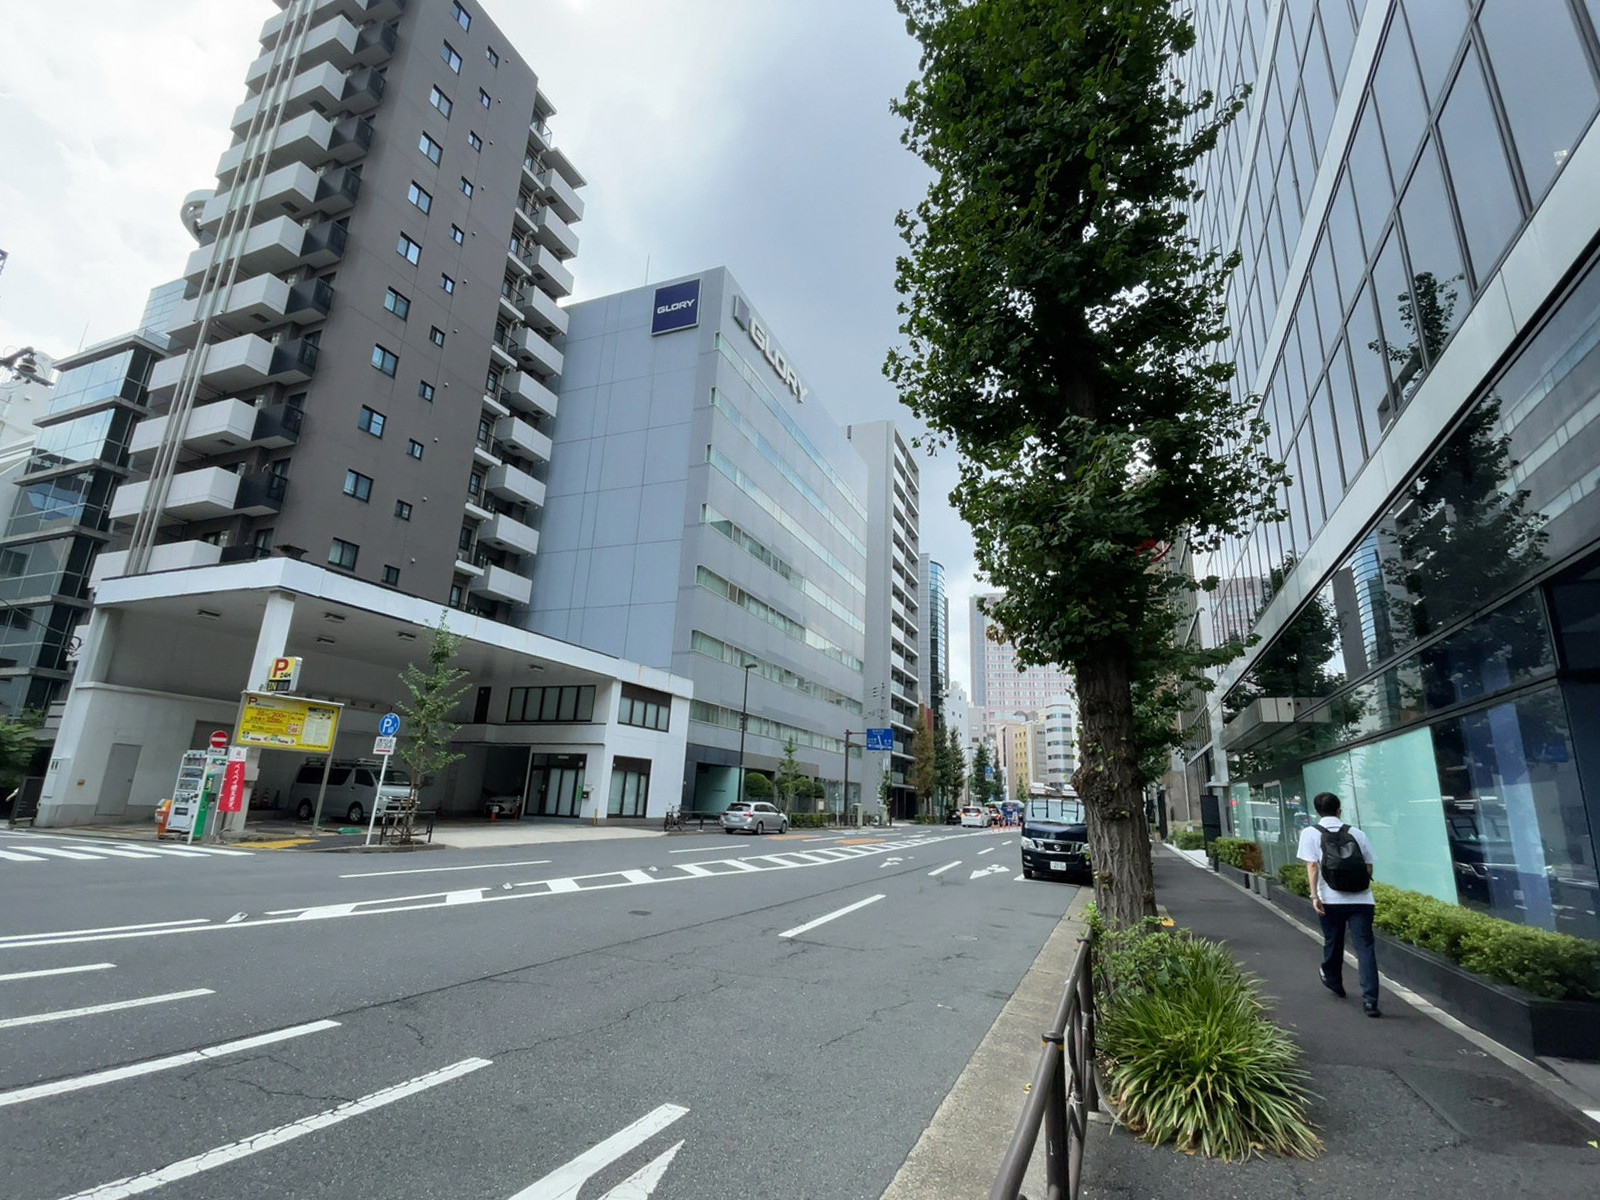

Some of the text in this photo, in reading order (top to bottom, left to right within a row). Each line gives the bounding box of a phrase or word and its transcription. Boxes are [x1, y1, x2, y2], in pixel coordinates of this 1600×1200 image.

[657, 299, 695, 314] GLORY
[751, 317, 808, 403] GLORY
[272, 658, 289, 678] P
[382, 718, 392, 732] P
